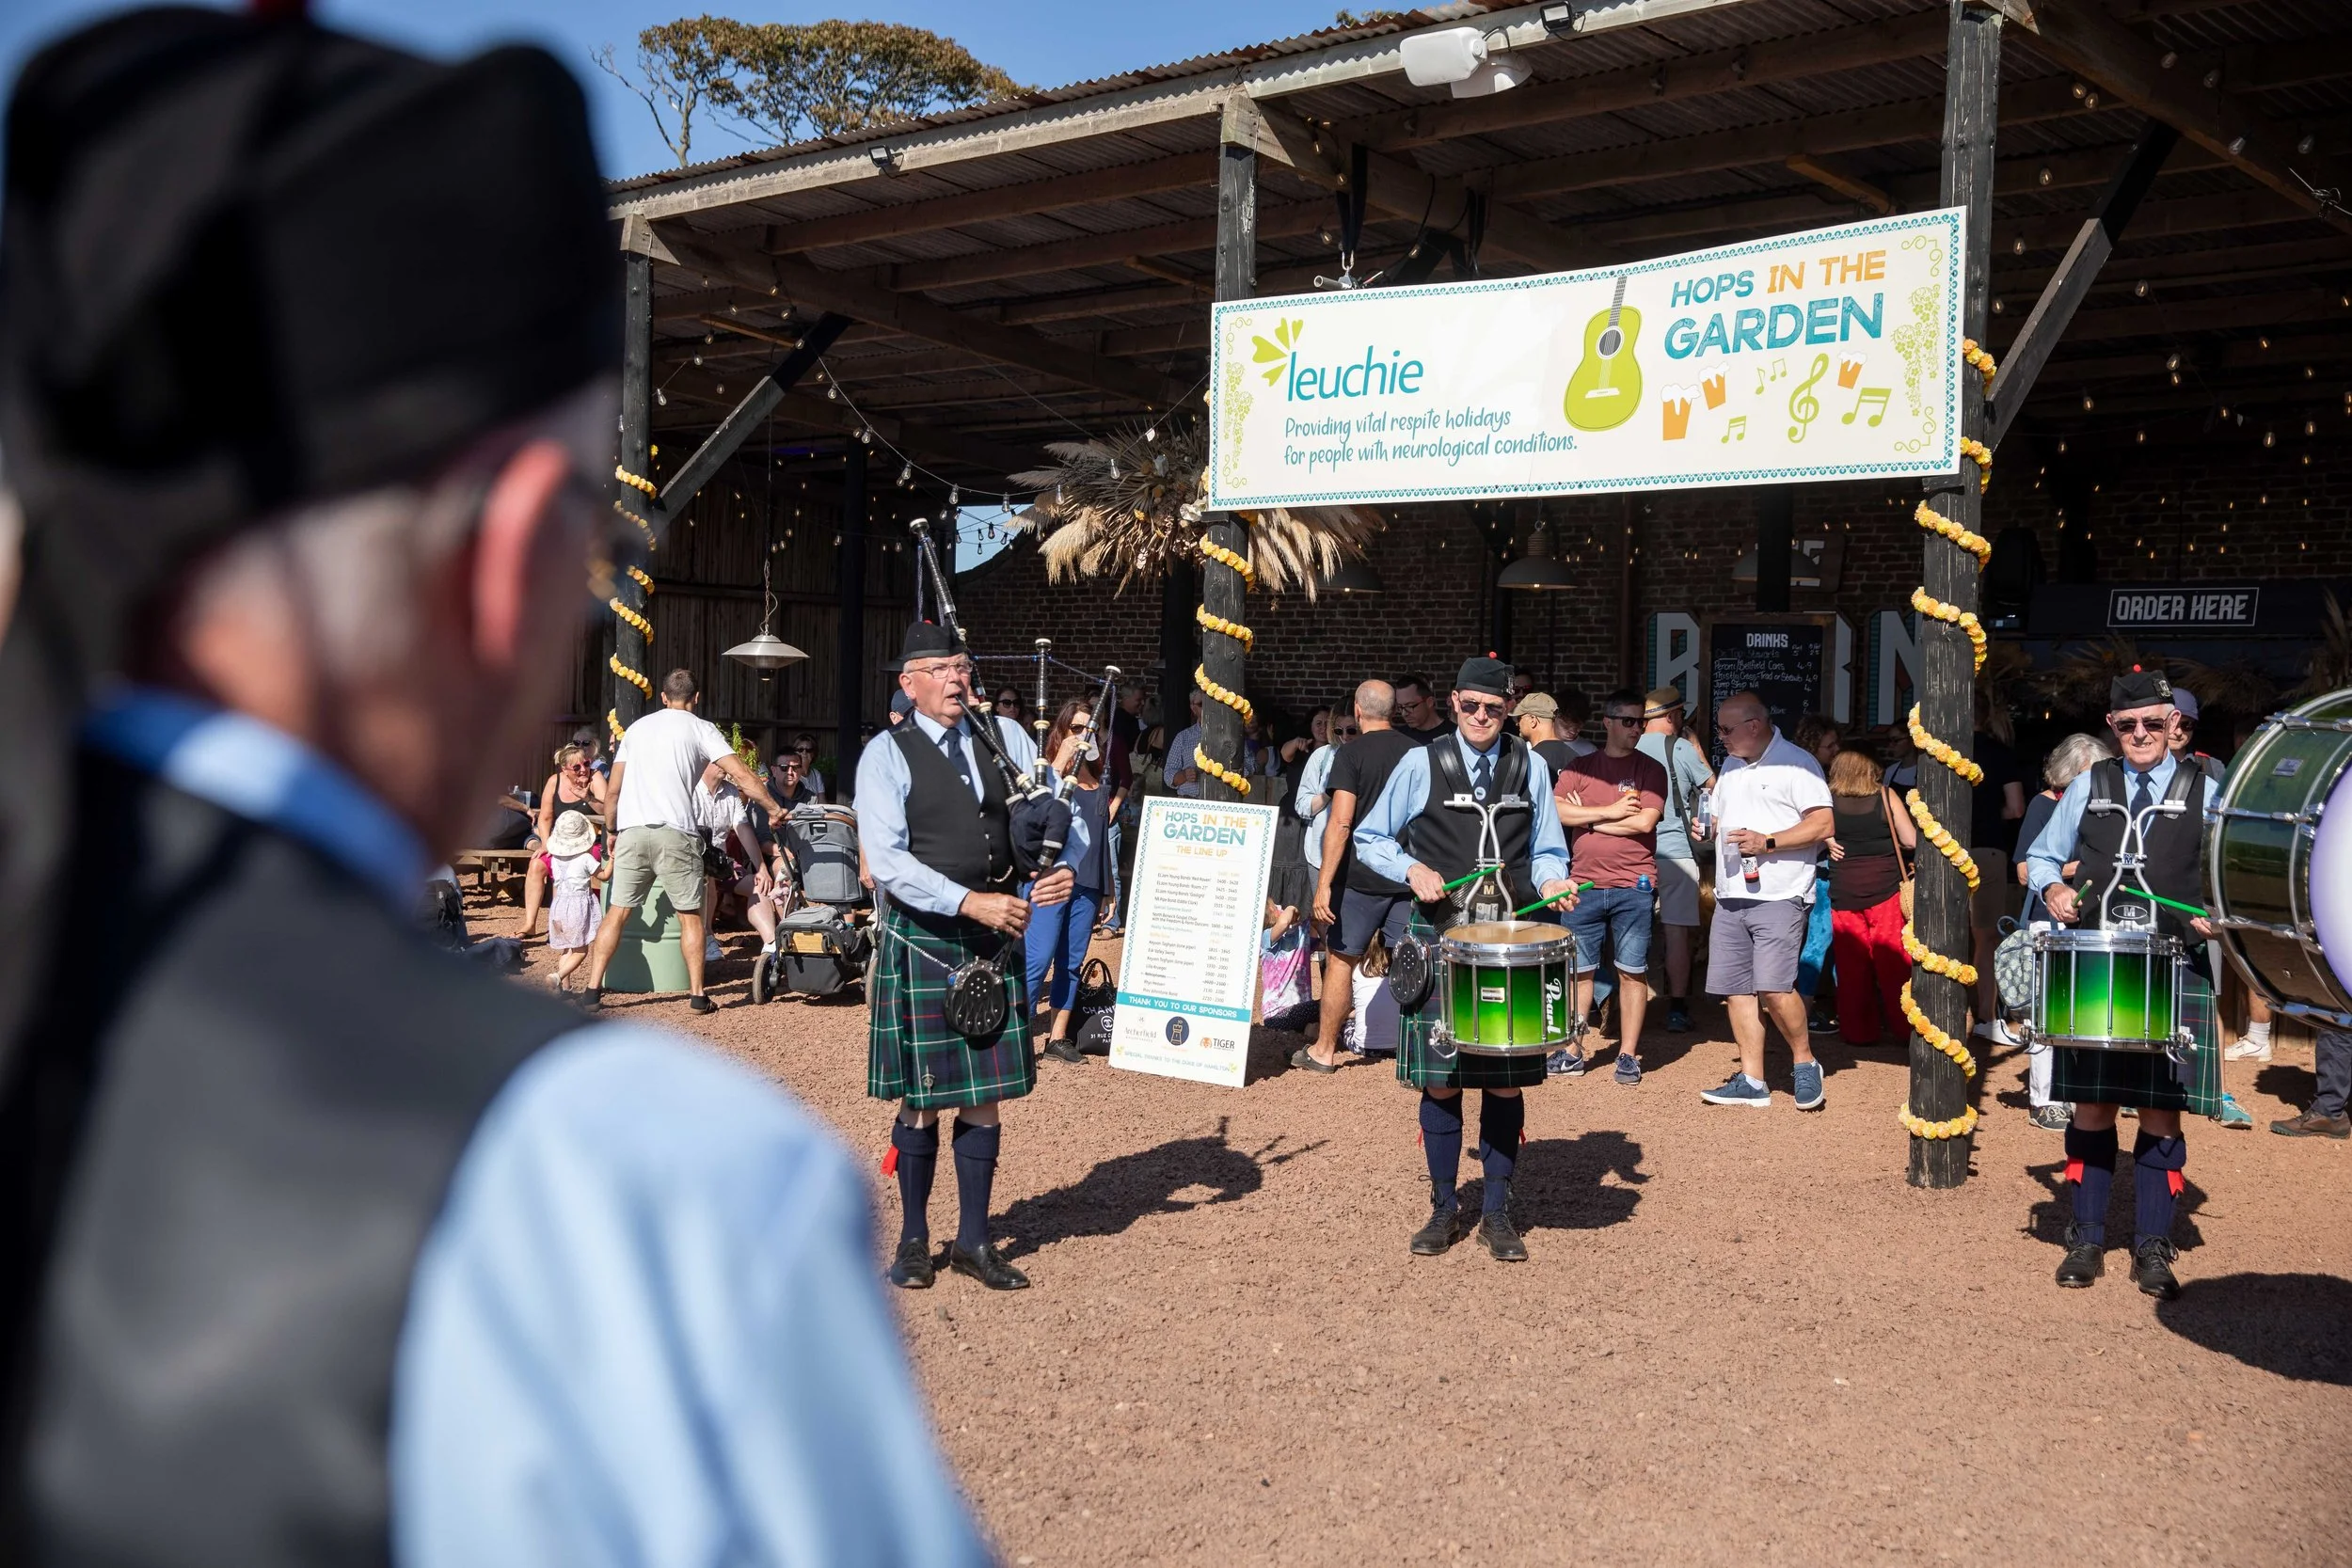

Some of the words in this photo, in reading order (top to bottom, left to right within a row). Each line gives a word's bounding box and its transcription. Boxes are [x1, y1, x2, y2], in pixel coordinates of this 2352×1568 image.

[1670, 269, 1756, 309] HOPS
[1767, 261, 1806, 294] IN
[1819, 249, 1887, 286] THE
[1664, 293, 1884, 360] GARDEN
[1287, 344, 1424, 402] leuchie
[1285, 416, 1351, 444] Providing
[1356, 410, 1387, 433] vital
[1391, 407, 1441, 440] respite
[1445, 405, 1511, 433] holidays
[1283, 444, 1306, 466] for
[1309, 442, 1354, 472] people
[1358, 438, 1389, 462] with
[1392, 433, 1491, 467] neurological
[1494, 430, 1579, 454] conditions.
[2116, 594, 2186, 621] ORDER
[2189, 594, 2249, 621] HERE
[1745, 633, 1788, 648] DRINKS
[1165, 811, 1199, 824] HOPS
[1202, 814, 1217, 826] IN
[1224, 816, 1248, 829] THE
[1163, 822, 1247, 846] GARDEN
[1176, 845, 1191, 854] THE
[1194, 846, 1214, 856] LINE
[1216, 848, 1228, 858] UP
[1483, 884, 1495, 895] M
[2123, 906, 2136, 917] M
[1082, 1006, 1117, 1016] CHAN
[1129, 996, 1152, 1006] THANK
[1153, 999, 1168, 1008] YOU
[1182, 1004, 1197, 1013] OUR
[1199, 1006, 1237, 1019] SPONSORS
[1546, 977, 1563, 1034] Pearl
[1213, 1037, 1235, 1050] TIGER
[1124, 1051, 1142, 1059] SPECIAL
[1144, 1053, 1162, 1062] THANKS
[1203, 1062, 1230, 1072] HAMILTON
